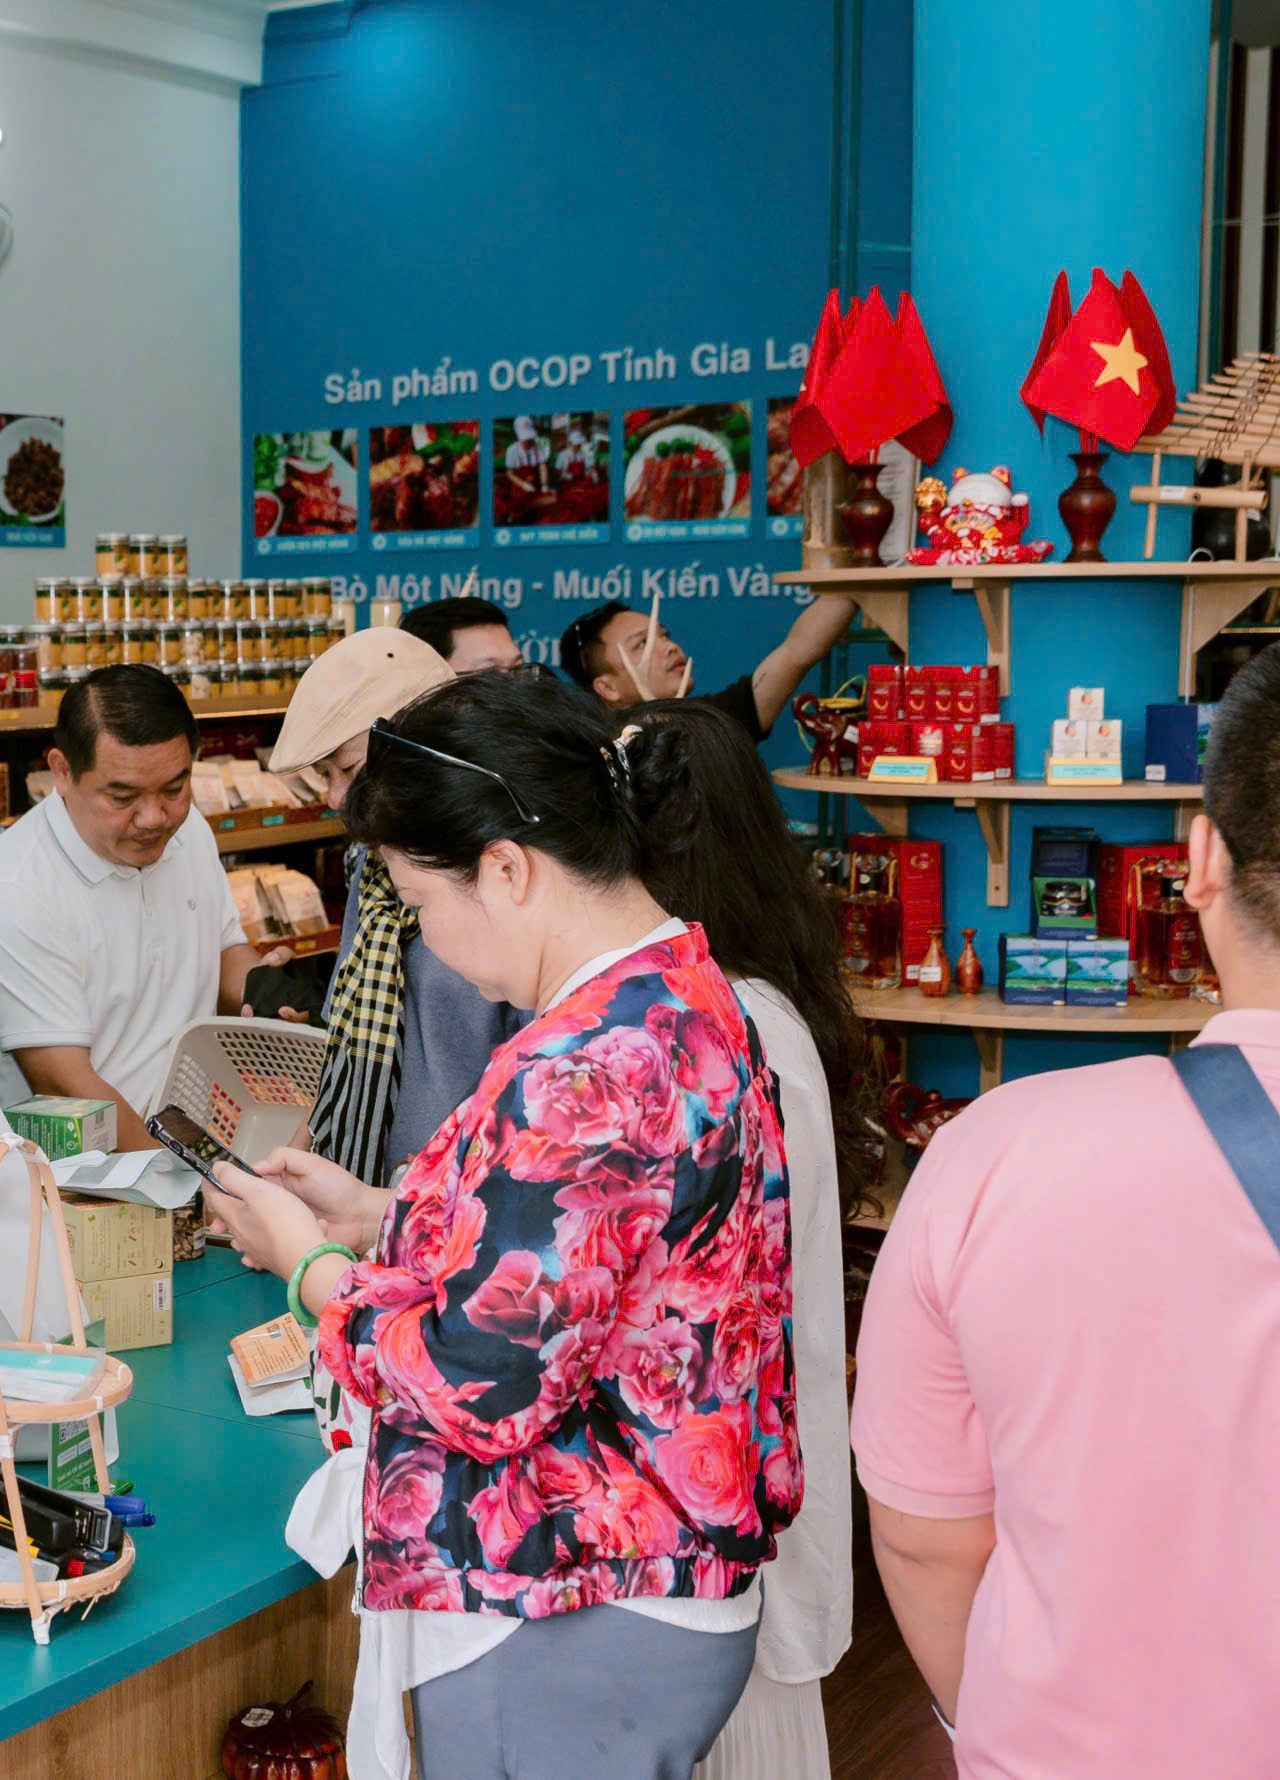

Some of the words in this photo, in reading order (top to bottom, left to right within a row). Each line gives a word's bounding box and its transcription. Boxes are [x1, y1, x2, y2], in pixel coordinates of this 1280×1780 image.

[324, 367, 382, 404] Sản
[392, 355, 479, 406] phẩm
[489, 354, 592, 392] OCOP
[599, 346, 676, 383] Tỉnh
[690, 341, 751, 376] Gia
[765, 337, 810, 371] La
[331, 573, 368, 603] Bò
[376, 573, 432, 610] Một
[553, 564, 632, 600] Muối
[641, 561, 719, 599] Kiến
